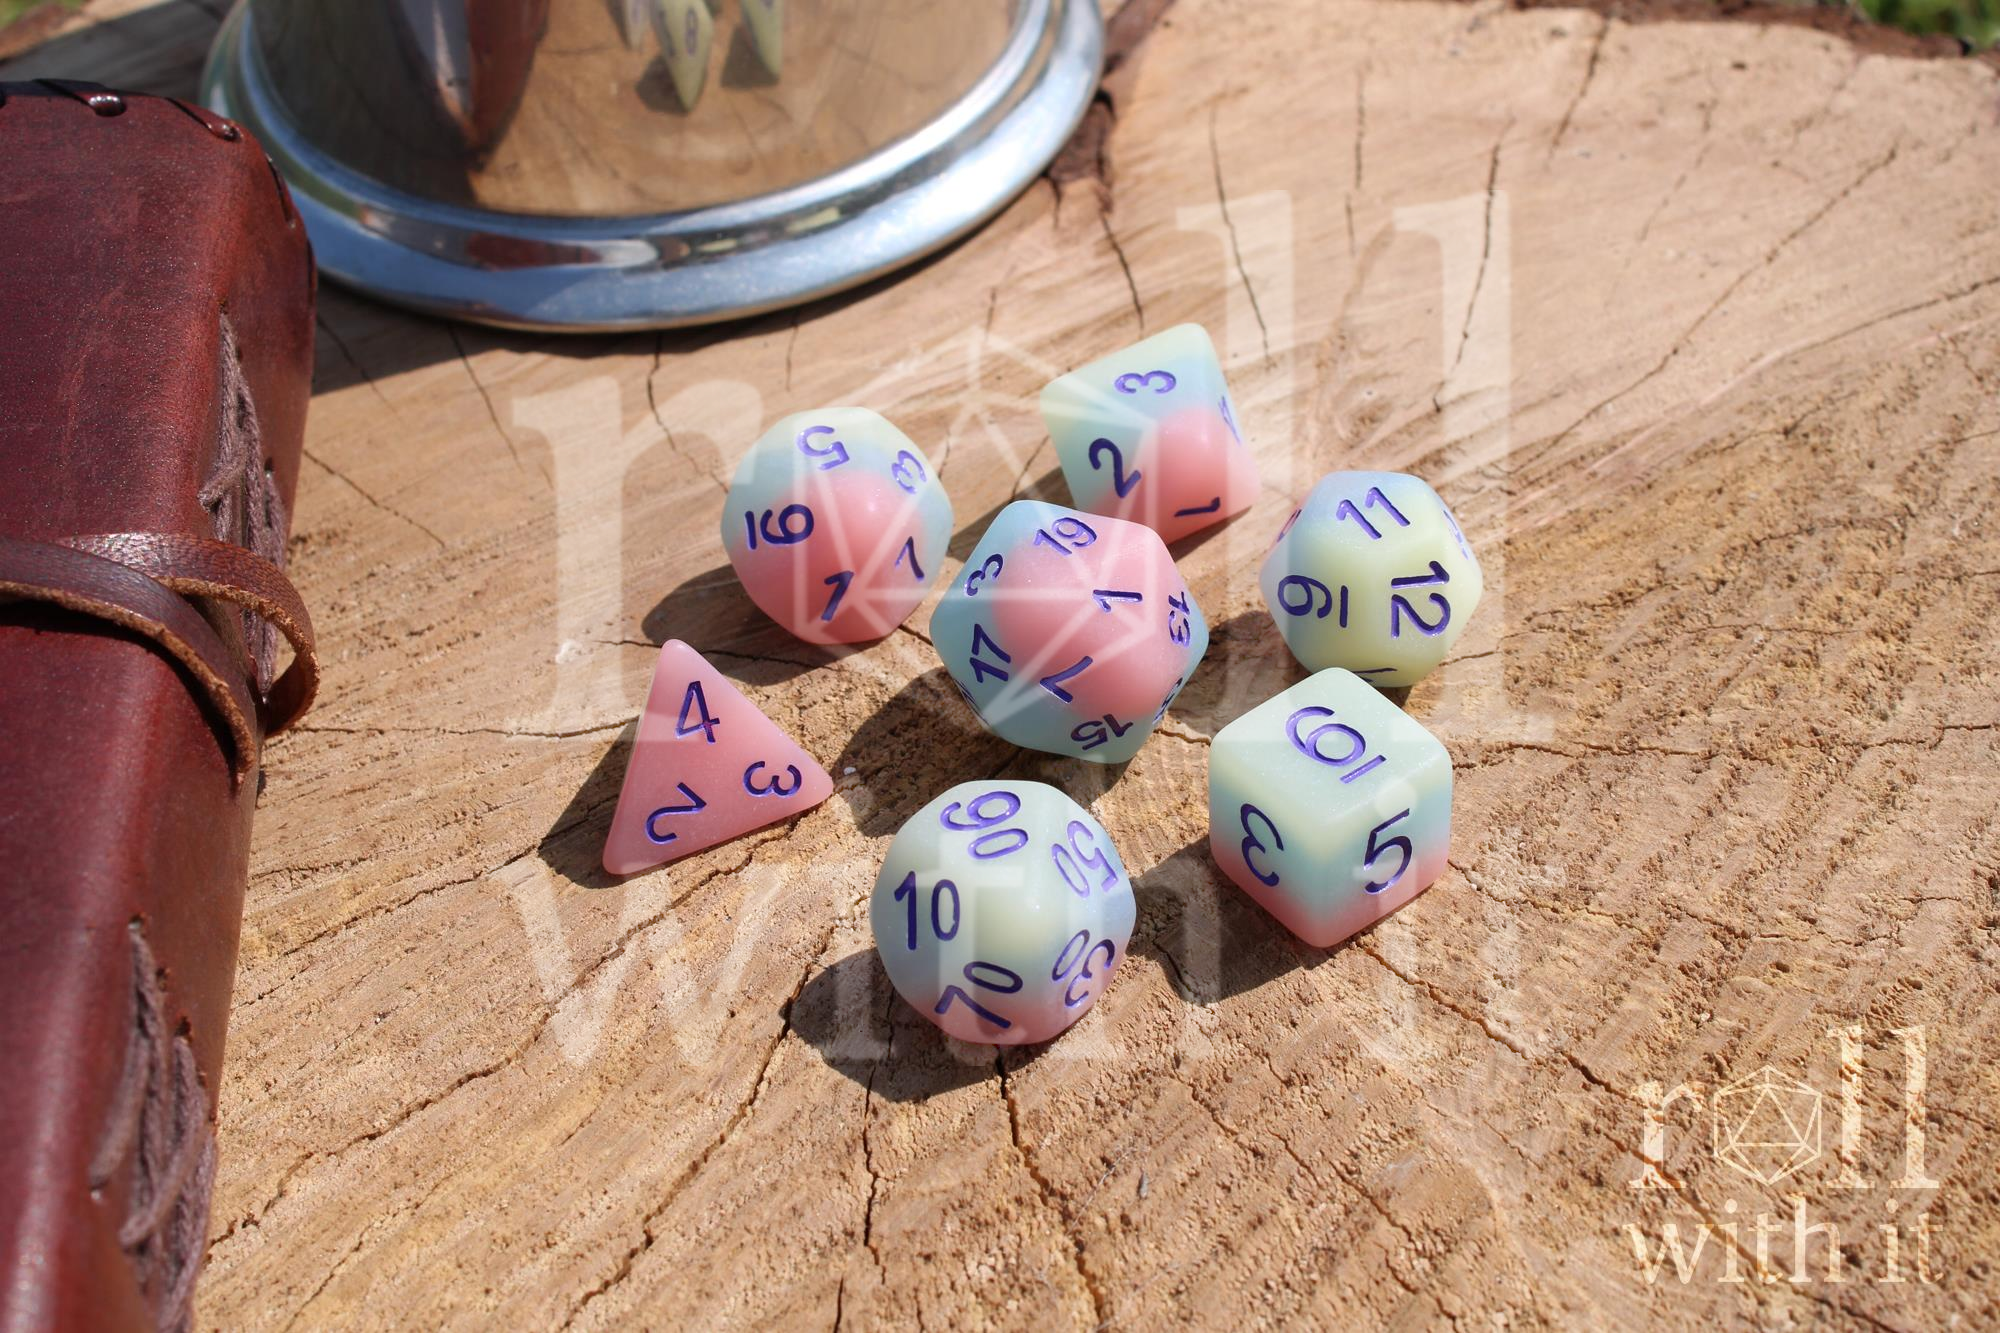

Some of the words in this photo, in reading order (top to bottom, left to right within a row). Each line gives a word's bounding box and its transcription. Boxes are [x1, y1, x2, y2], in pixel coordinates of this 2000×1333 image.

[1114, 370, 1176, 394] 3
[797, 426, 850, 470] 5
[892, 450, 927, 494] 3
[1089, 438, 1141, 498] 2
[1033, 517, 1097, 556] 19
[1336, 487, 1390, 539] 11
[821, 570, 854, 621] 1
[965, 553, 1003, 596] 3
[1391, 560, 1451, 639] 12
[1168, 591, 1191, 647] 13
[970, 623, 1011, 683] 17
[1040, 656, 1093, 703] 7
[675, 680, 720, 744] 4
[1070, 714, 1133, 750] 15
[743, 761, 802, 798] 3
[646, 782, 707, 845] 2
[940, 790, 1028, 860] 90
[1051, 820, 1119, 897] 50
[1240, 803, 1284, 887] 3
[1363, 808, 1412, 895] 5
[894, 871, 960, 951] 10
[934, 961, 1023, 1029] 70
[1052, 929, 1116, 1008] 30
